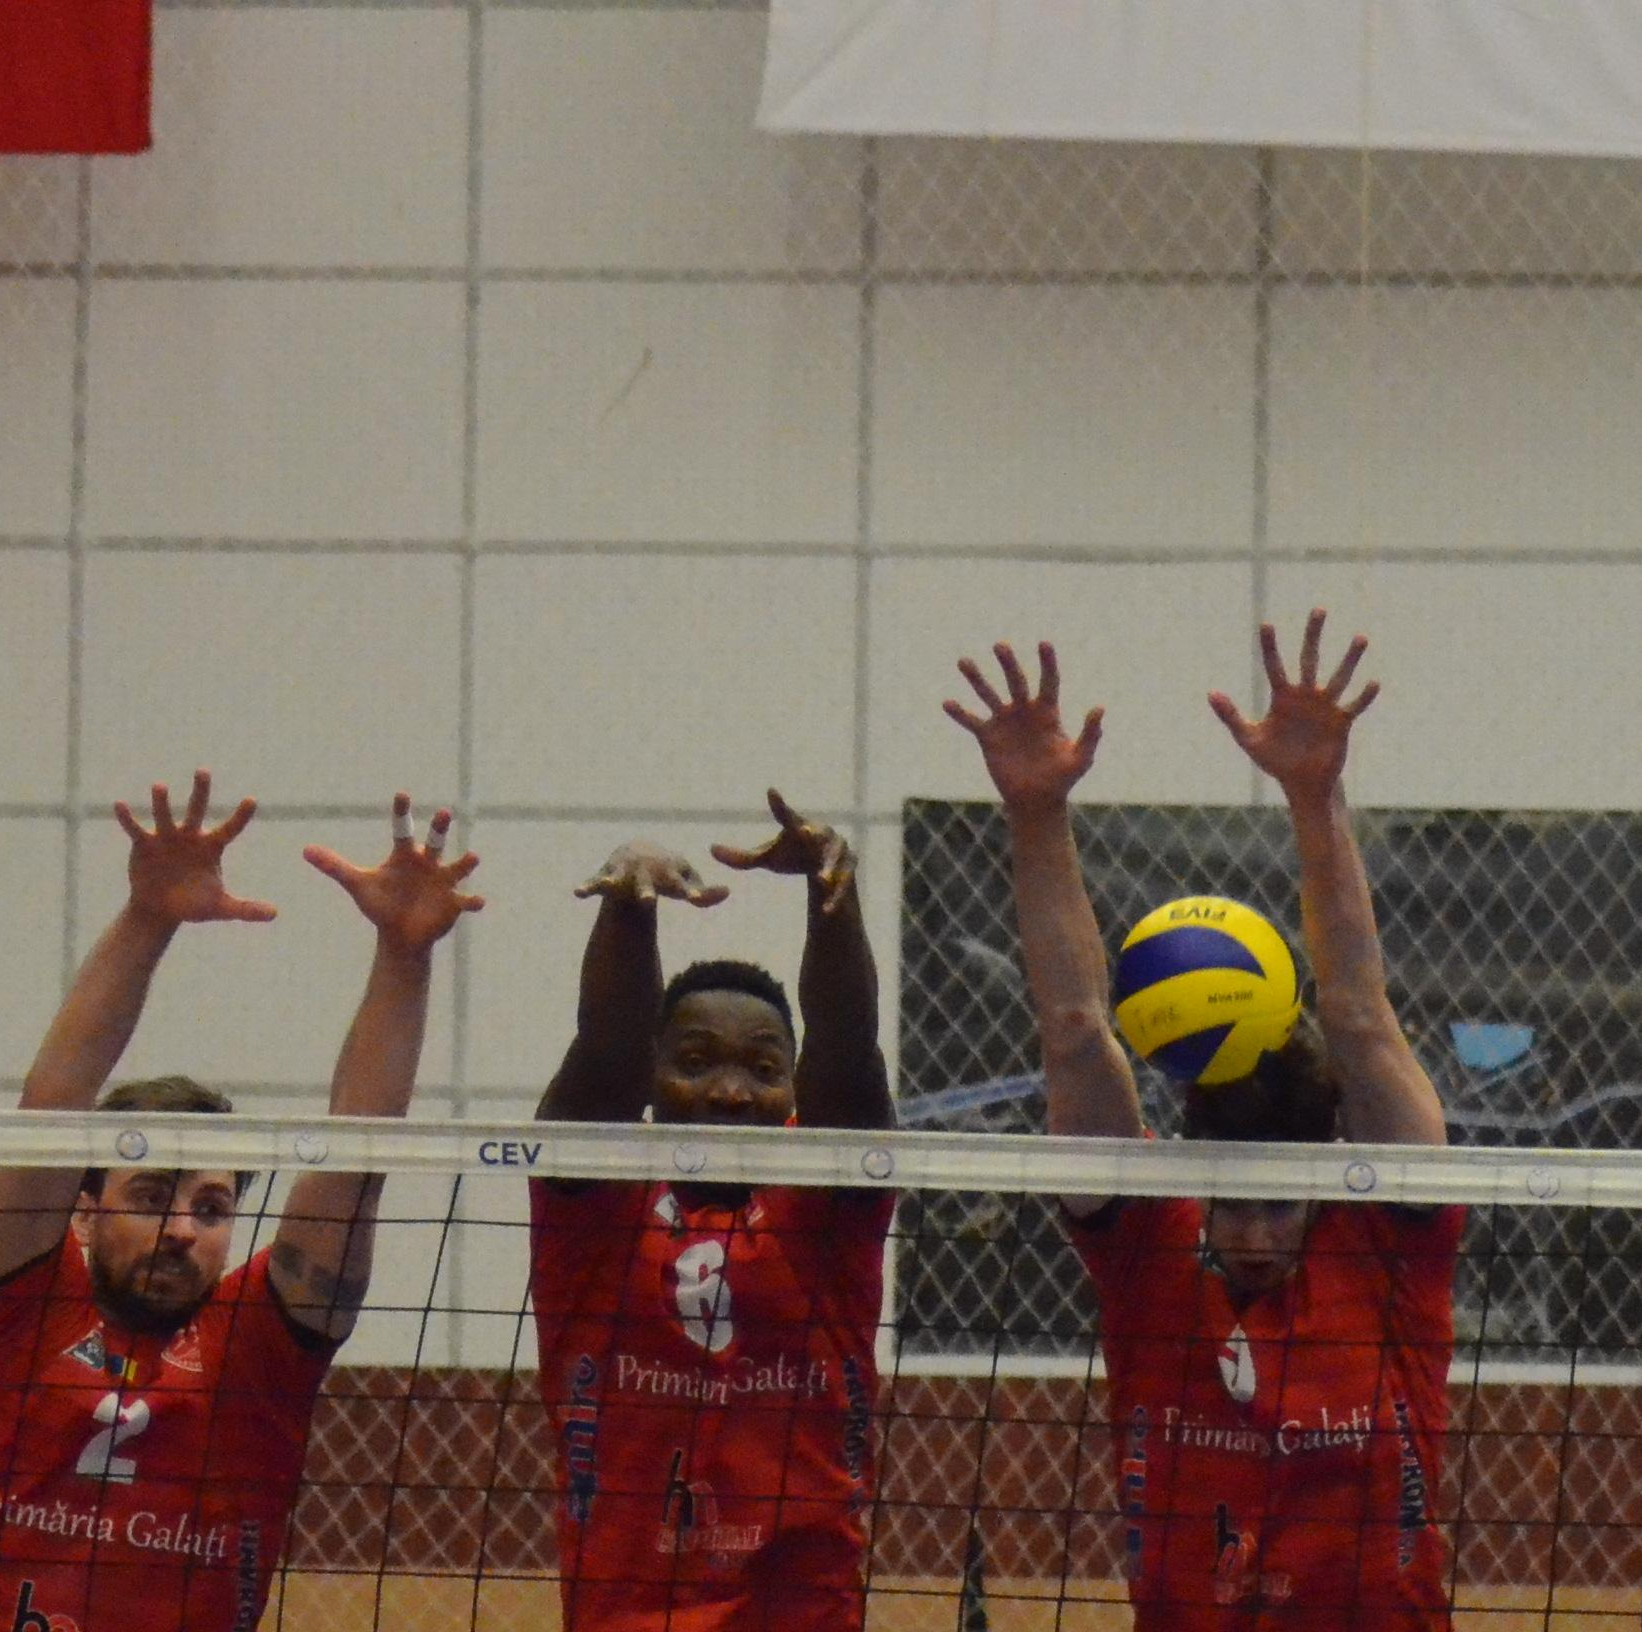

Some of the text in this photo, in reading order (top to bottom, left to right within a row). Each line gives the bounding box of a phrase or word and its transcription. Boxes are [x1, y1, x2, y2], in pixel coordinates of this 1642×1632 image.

[478, 1142, 542, 1168] CEV
[75, 1393, 149, 1484] 2
[125, 1511, 227, 1566] Galați
